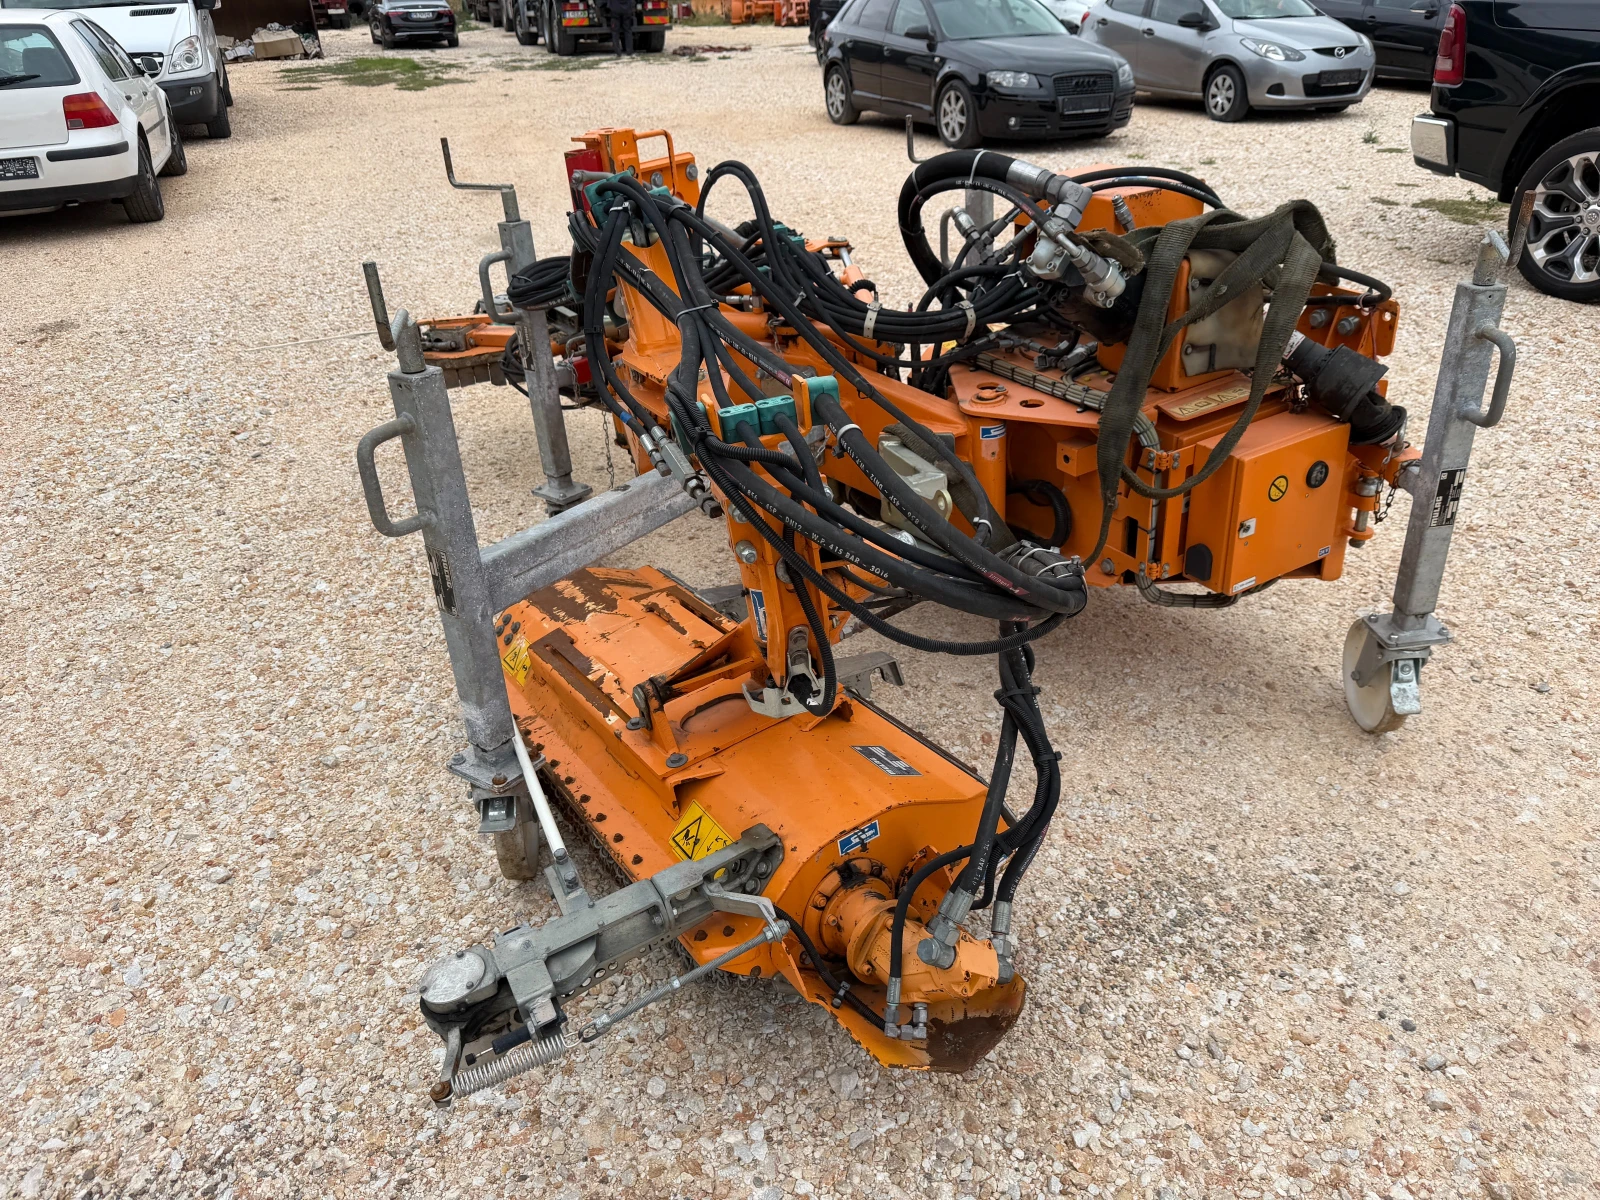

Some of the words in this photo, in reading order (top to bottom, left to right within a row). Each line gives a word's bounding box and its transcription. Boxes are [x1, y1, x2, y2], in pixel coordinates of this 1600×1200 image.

[1430, 495, 1443, 527] MULAG
[785, 516, 802, 531] DN12
[844, 551, 860, 564] BAR
[977, 857, 985, 871] BAR
